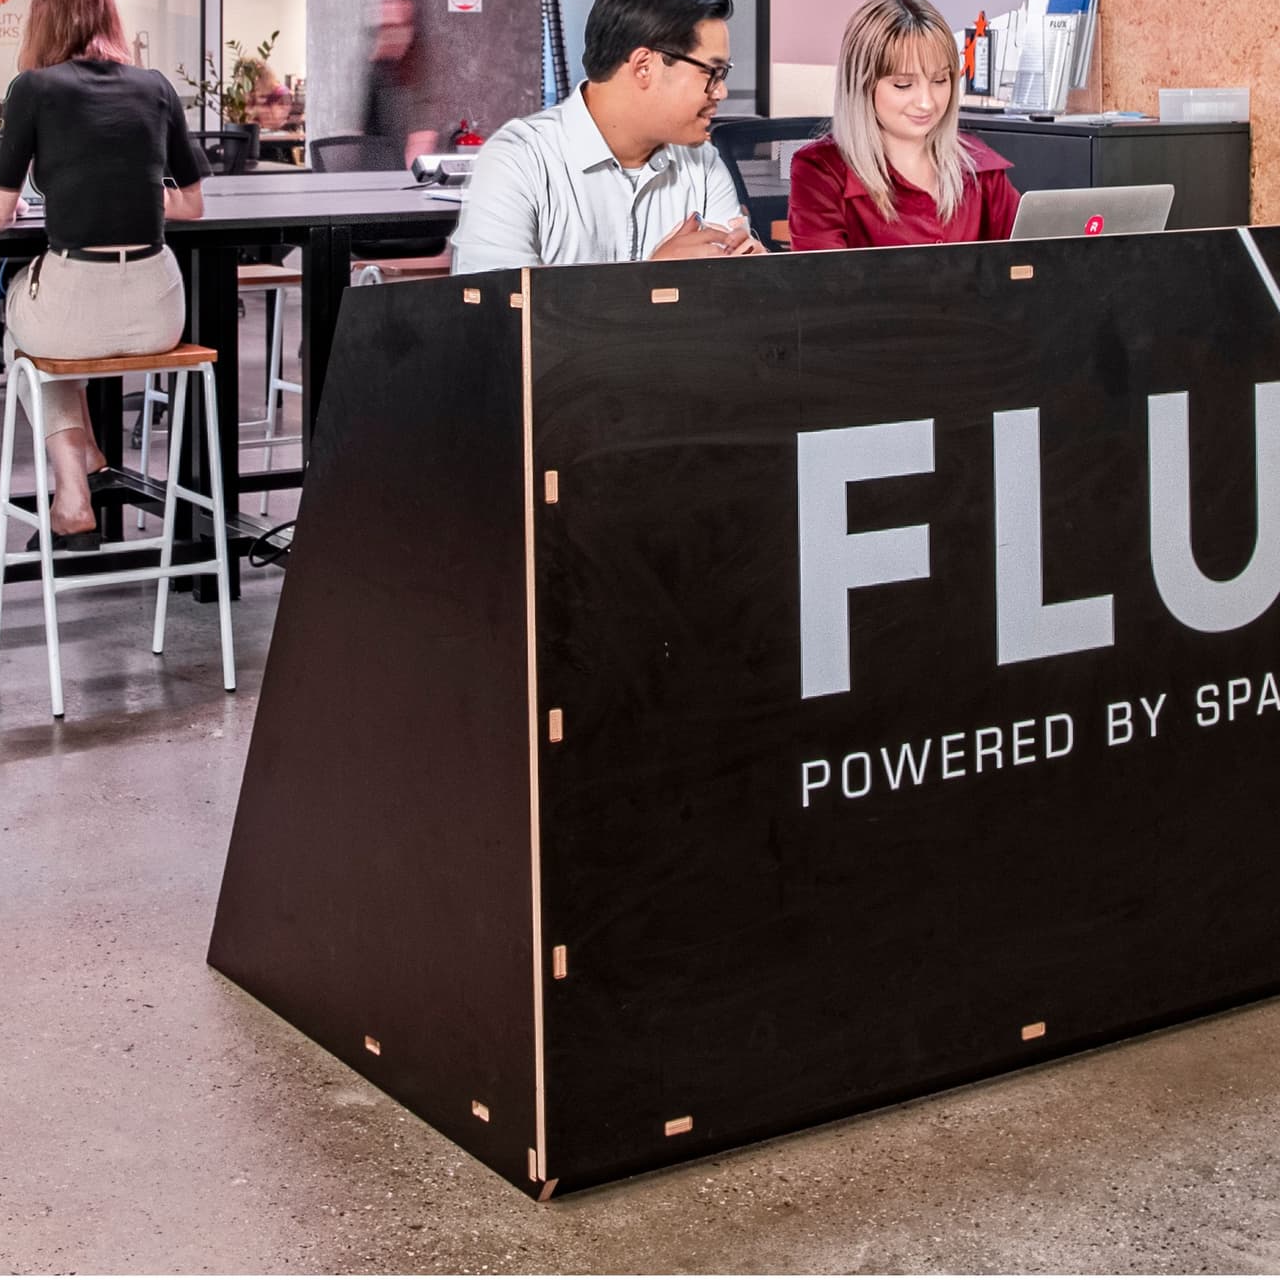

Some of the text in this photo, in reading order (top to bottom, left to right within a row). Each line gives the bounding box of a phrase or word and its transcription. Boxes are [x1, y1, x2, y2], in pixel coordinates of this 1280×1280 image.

[1049, 20, 1067, 28] FLUX
[801, 713, 1075, 808] POWERED
[1107, 693, 1167, 747] BY
